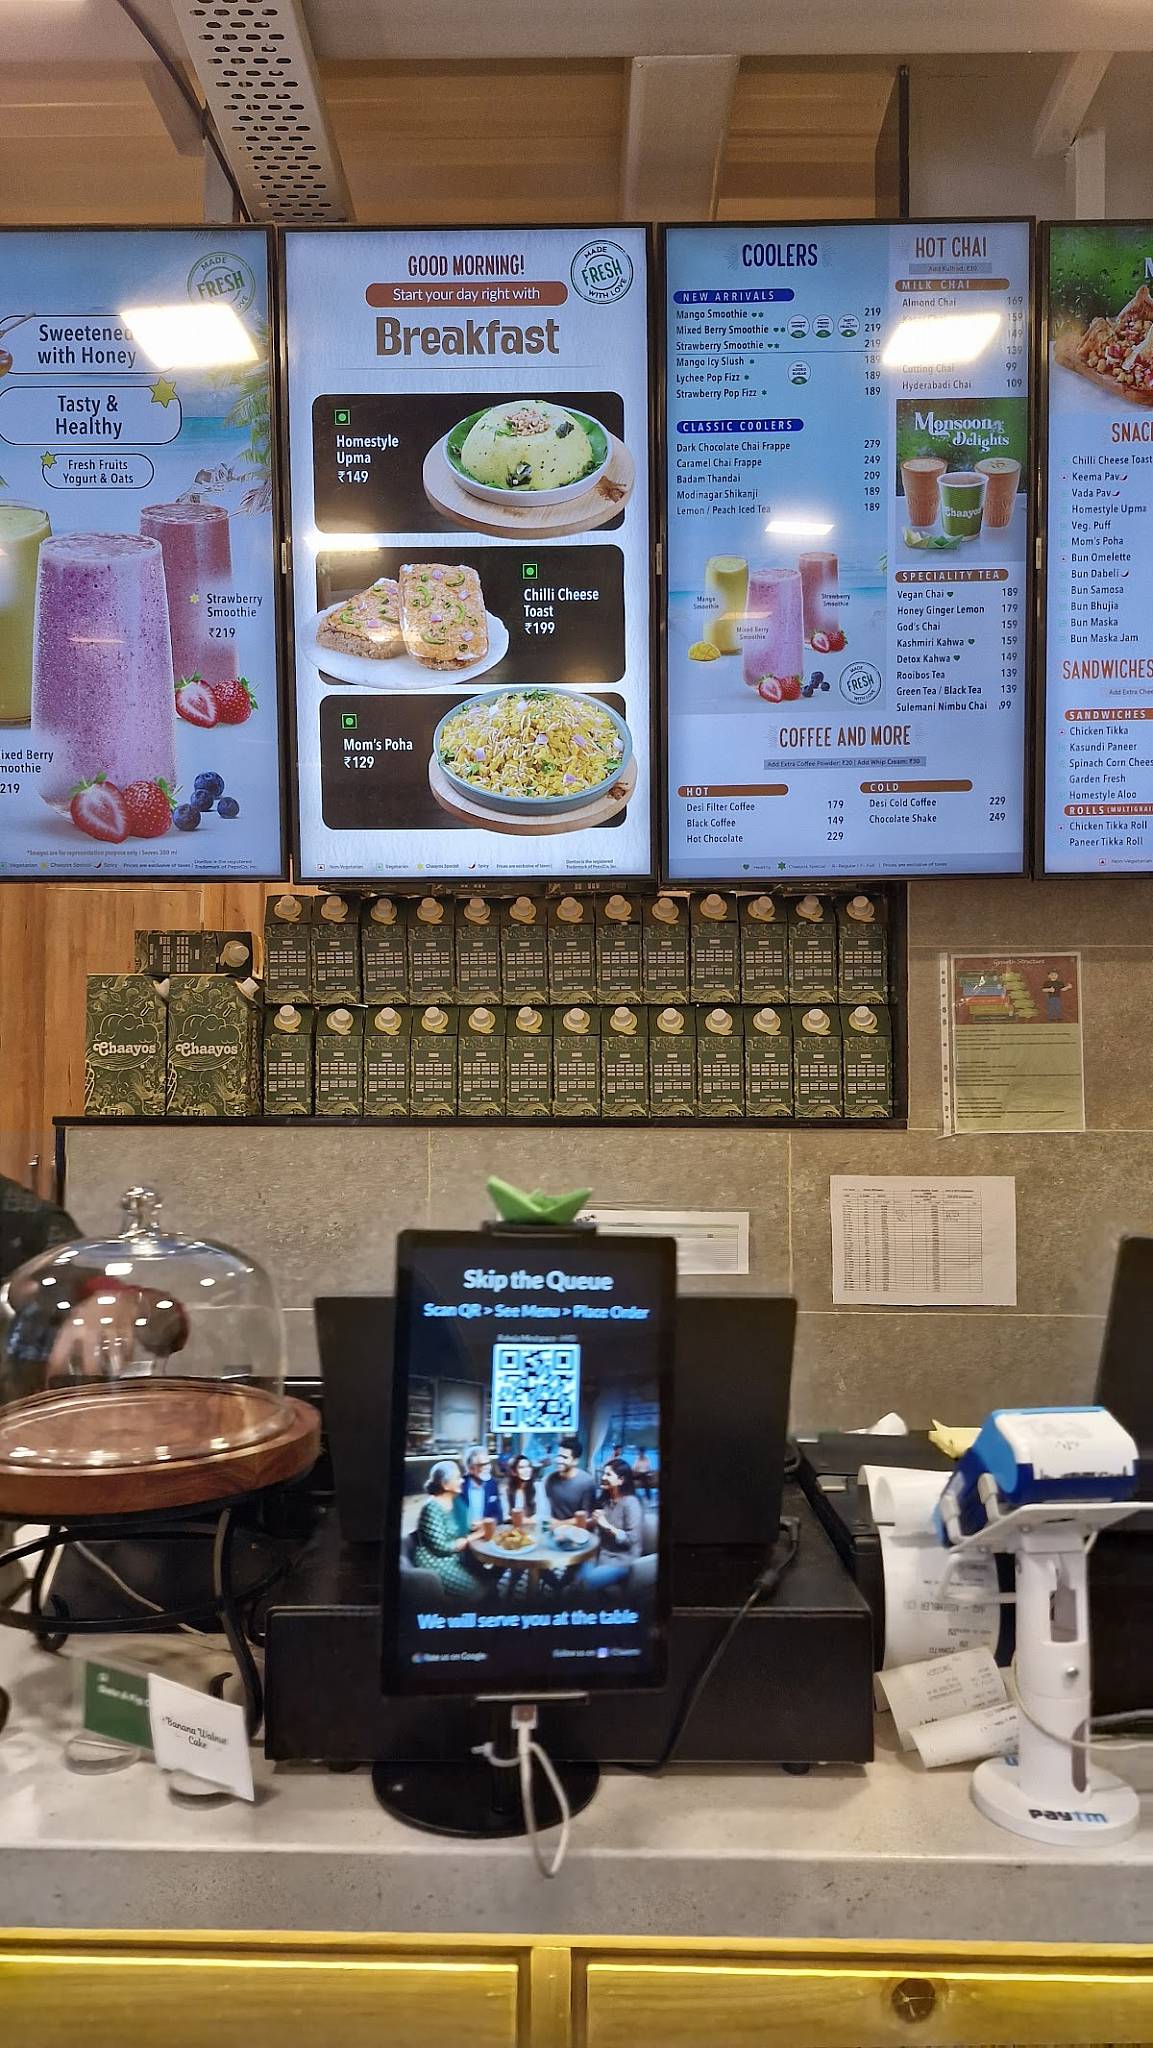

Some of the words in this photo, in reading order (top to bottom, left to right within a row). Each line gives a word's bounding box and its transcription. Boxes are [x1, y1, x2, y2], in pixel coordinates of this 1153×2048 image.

[584, 247, 607, 258] MADE
[916, 237, 947, 258] HOT
[952, 237, 986, 257] CHAI
[742, 244, 818, 267] COOLERS
[408, 255, 447, 276] GOOD
[453, 255, 525, 275] MORNING!
[581, 259, 622, 285] FRESH
[197, 270, 245, 297] FRESH
[589, 290, 608, 298] WITH
[611, 278, 626, 295] LOVE
[902, 280, 932, 289] MILK
[941, 280, 970, 289] CHAI
[393, 289, 422, 301] Start
[425, 290, 454, 303] your
[457, 289, 478, 303] day
[482, 289, 509, 302] right
[513, 288, 540, 300] with
[683, 292, 709, 302] NEW
[715, 291, 774, 300] ARRIVALS
[677, 310, 705, 320] Mango
[707, 309, 748, 318] Smoothie
[864, 308, 880, 316] 219
[677, 325, 702, 334] Mixed
[704, 326, 726, 335] Berry
[729, 325, 769, 334] Smoothie
[864, 324, 880, 332] 219
[376, 317, 559, 356] Breakfast
[676, 342, 722, 352] Strawberry
[724, 341, 764, 349] Smoothie
[864, 340, 880, 348] 219
[38, 347, 77, 364] with
[82, 347, 136, 369] Honey
[677, 389, 721, 399] Strawberry
[724, 389, 739, 399] Pop
[742, 389, 757, 397] Fizz
[865, 387, 880, 396] 189
[57, 395, 101, 416] Tasty
[106, 395, 118, 412] &
[55, 417, 123, 440] Healthy
[683, 422, 733, 432] CLASSIC
[739, 421, 793, 431] COOLERS
[914, 411, 992, 436] Monsoon
[336, 434, 399, 449] Homestyle
[677, 443, 696, 452] Dark
[699, 443, 739, 452] Chocolate
[742, 442, 760, 451] Chai
[762, 442, 790, 452] Frappe
[864, 440, 880, 448] 279
[953, 431, 1009, 452] Delights
[68, 459, 95, 470] Fresh
[99, 459, 128, 470] Fruits
[336, 452, 371, 465] Upma
[1072, 456, 1095, 464] Chilli
[1099, 456, 1129, 464] Cheese
[1132, 455, 1152, 463] Toast
[63, 473, 97, 486] Yogurt
[100, 473, 107, 483] &
[110, 473, 134, 484] Oats
[338, 471, 368, 483] ₹149
[677, 475, 705, 483] Badam
[708, 474, 741, 483] Thandai
[864, 472, 880, 480] 209
[1073, 473, 1102, 481] Keema
[1105, 472, 1120, 480] Pav
[1072, 489, 1093, 497] Vada
[1097, 489, 1111, 497] Pav
[1103, 537, 1123, 545] Poha
[1091, 553, 1131, 561] Omelette
[902, 571, 972, 581] SPECIALITY
[979, 571, 999, 579] TEA
[207, 594, 262, 606] Strawberry
[524, 588, 555, 601] Chilli
[558, 588, 599, 601] Cheese
[897, 590, 923, 600] Vegan
[926, 590, 944, 598] Chai
[1002, 588, 1018, 596] 189
[207, 606, 257, 618] Smoothie
[524, 605, 553, 617] Toast
[897, 607, 923, 617] Honey
[926, 606, 954, 616] Ginger
[957, 605, 984, 613] Lemon
[1002, 604, 1018, 612] 179
[208, 627, 236, 638] ₹219
[524, 622, 555, 634] ₹199
[897, 639, 934, 647] Kashmiri
[937, 638, 964, 646] Kahwa
[1001, 636, 1017, 645] 159
[1071, 635, 1087, 643] Bun
[1091, 634, 1118, 642] Maska
[1120, 634, 1138, 642] Jam
[897, 655, 920, 663] Detox
[923, 654, 950, 663] Kahwa
[1001, 652, 1017, 661] 149
[1070, 710, 1146, 720] SANDWICHES
[779, 728, 831, 747] COFFEE
[837, 726, 866, 747] AND
[871, 725, 911, 745] MORE
[1070, 727, 1104, 735] Chicken
[1106, 727, 1128, 735] Tikka
[343, 738, 382, 751] Mom's
[385, 738, 413, 751] Poha
[344, 756, 375, 769] ₹129
[687, 787, 709, 795] HOT
[870, 783, 899, 792] COLD
[870, 799, 887, 807] Desi
[890, 798, 908, 807] Cold
[911, 798, 937, 806] Coffee
[989, 797, 1006, 805] 229
[1070, 806, 1104, 815] ROLLS
[687, 820, 708, 828] Black
[711, 819, 736, 827] Coffee
[869, 815, 910, 823] Chocolate
[912, 814, 937, 822] Shake
[989, 813, 1006, 821] 249
[1070, 822, 1104, 830] Chicken
[1106, 822, 1128, 830] Tikka
[1131, 821, 1147, 829] Roll
[687, 835, 701, 843] Hot
[703, 834, 743, 842] Chocolate
[827, 832, 843, 840] 229
[1070, 838, 1099, 846] Paneer
[1101, 838, 1123, 846] Tikka
[1126, 837, 1143, 845] Roll
[93, 1042, 156, 1056] Chaayos
[175, 1042, 238, 1056] Chaayos
[463, 1269, 508, 1292] Skip
[510, 1270, 543, 1290] the
[546, 1270, 614, 1292] Queue
[424, 1303, 456, 1317] Scan
[458, 1304, 482, 1318] QR
[494, 1304, 519, 1318] See
[521, 1305, 560, 1318] Menu
[573, 1305, 608, 1319] Place
[610, 1306, 649, 1320] Order
[417, 1614, 445, 1629] We
[447, 1613, 477, 1628] will
[478, 1615, 520, 1628] serve
[521, 1615, 551, 1629] you
[552, 1612, 569, 1626] at
[571, 1610, 597, 1625] the
[600, 1609, 639, 1625] table
